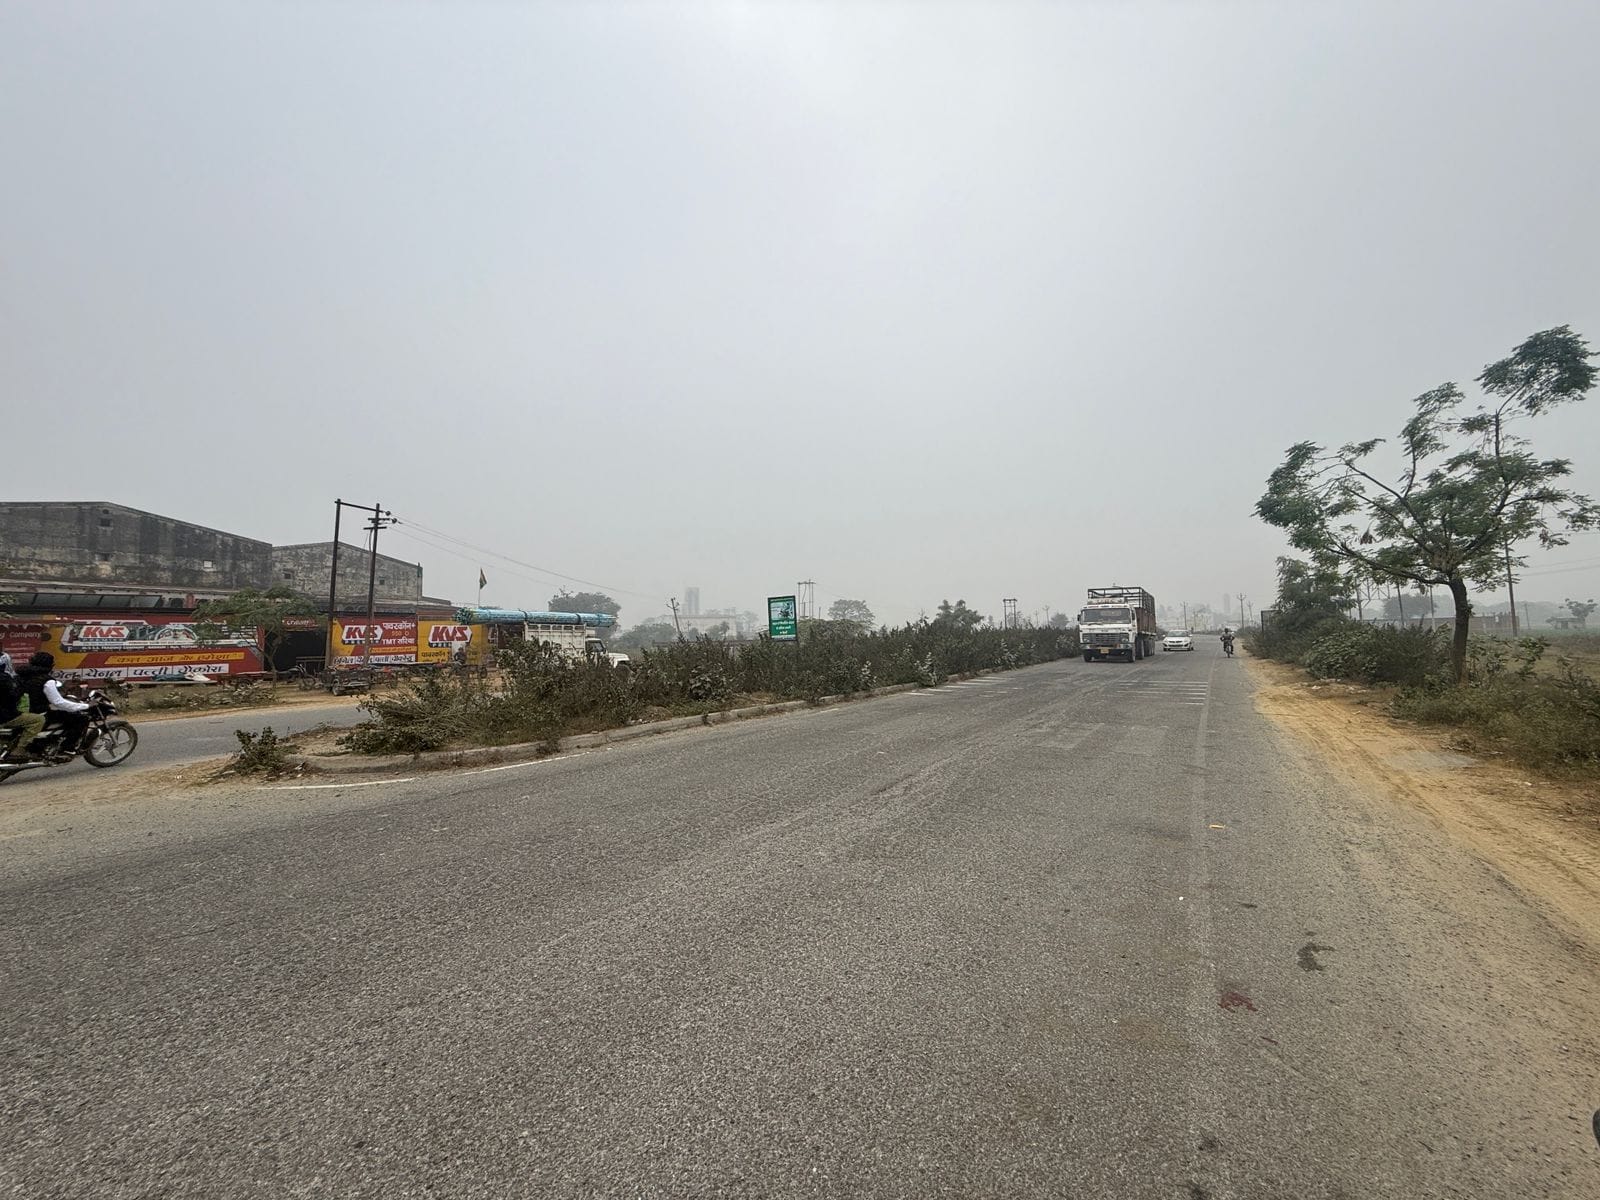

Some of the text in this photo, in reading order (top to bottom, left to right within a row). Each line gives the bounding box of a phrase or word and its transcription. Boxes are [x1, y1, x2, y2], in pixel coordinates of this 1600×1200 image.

[83, 626, 125, 637] KVS
[345, 626, 379, 639] KVS
[431, 626, 468, 641] KVS
